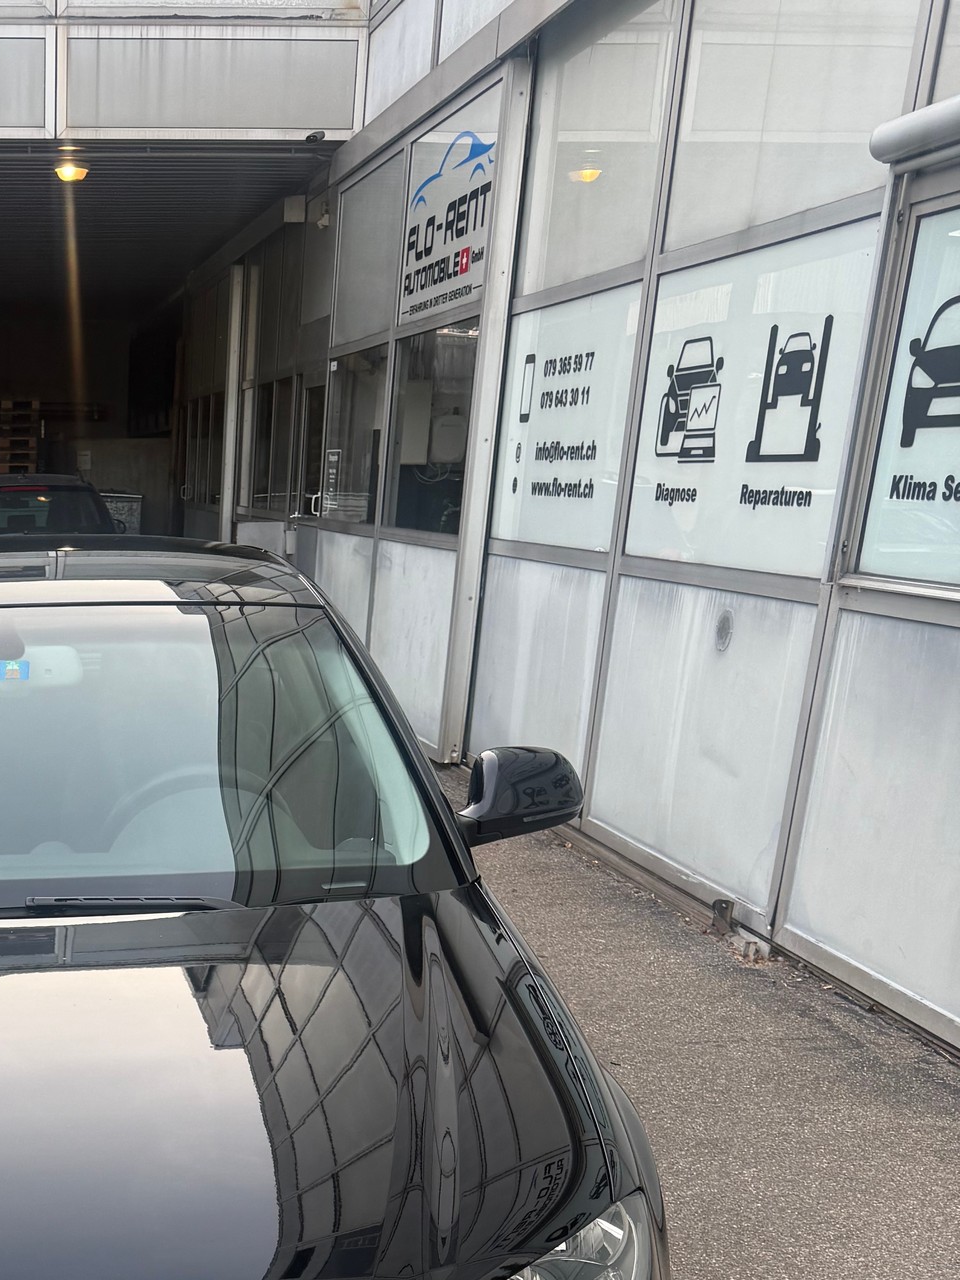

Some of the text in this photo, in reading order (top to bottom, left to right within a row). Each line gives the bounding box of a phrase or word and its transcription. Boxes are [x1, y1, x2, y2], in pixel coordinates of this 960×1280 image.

[405, 180, 492, 267] FLO-RENT
[403, 251, 461, 298] AUTOMOBILE
[543, 351, 595, 378] 079 365 59 77
[540, 385, 590, 409] 079 643 30 11
[535, 440, 597, 463] info@flo-rent.ch
[531, 477, 594, 499] www.flo-rent.ch
[655, 483, 697, 507] Diagnose
[740, 484, 813, 510] Reparaturen
[889, 474, 938, 501] Klima
